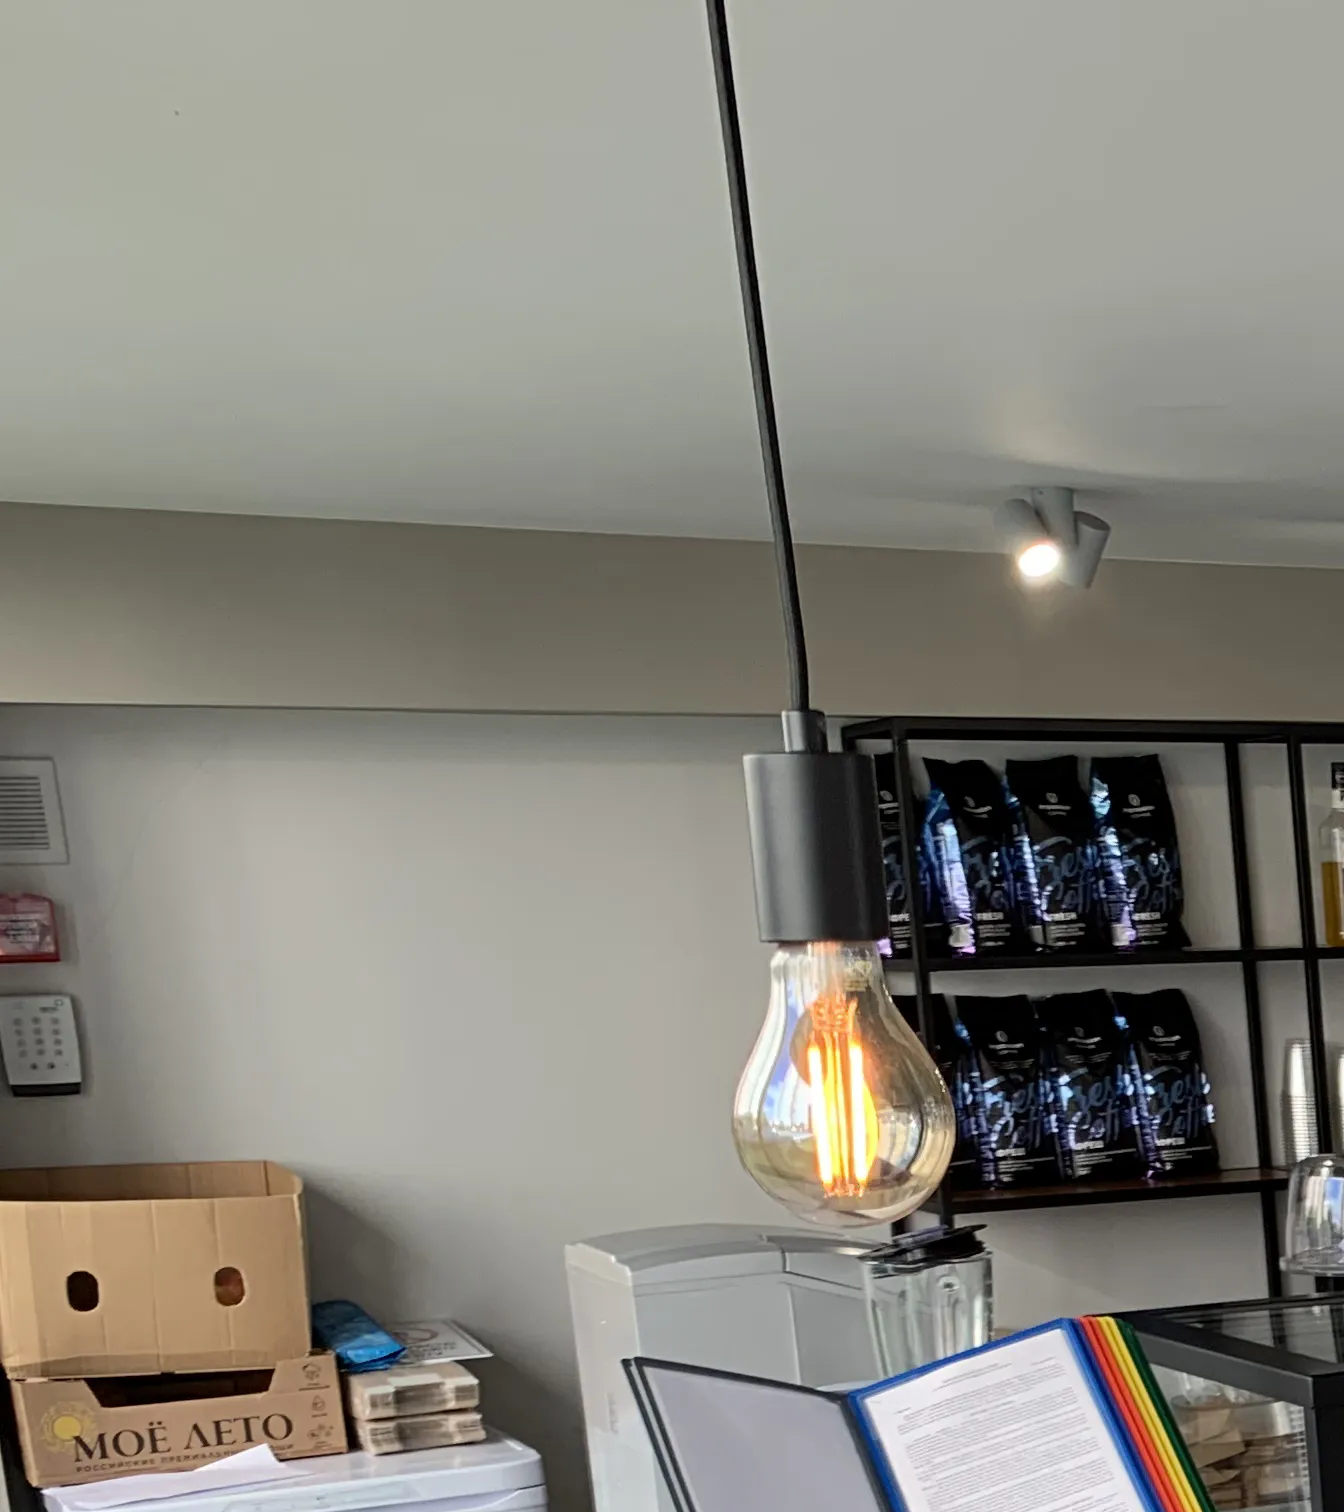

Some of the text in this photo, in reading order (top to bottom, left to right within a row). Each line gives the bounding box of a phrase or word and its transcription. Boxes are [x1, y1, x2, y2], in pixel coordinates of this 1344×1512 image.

[73, 1413, 293, 1463] МОЁ ЛЕТО
[75, 1457, 156, 1473] РОССИЙСКИЕ
